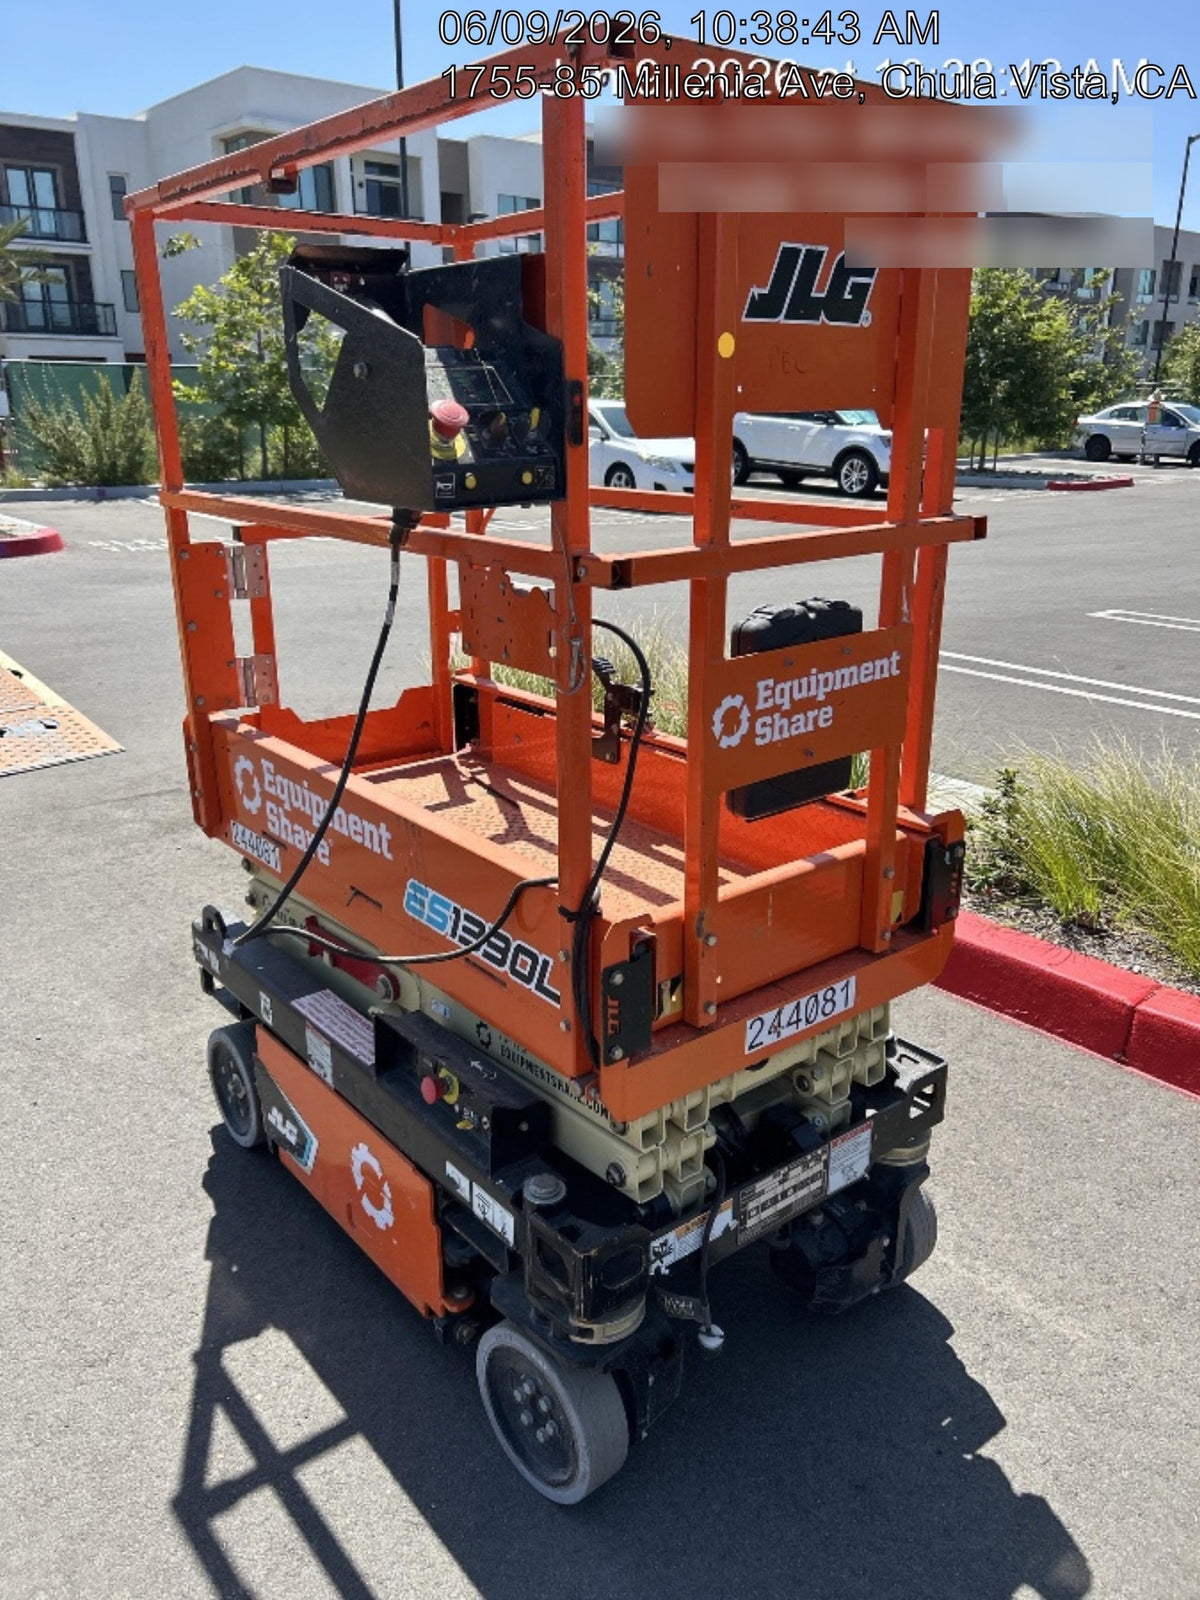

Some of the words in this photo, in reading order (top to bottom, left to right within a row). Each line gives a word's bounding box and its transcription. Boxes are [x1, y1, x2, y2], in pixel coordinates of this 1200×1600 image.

[741, 242, 879, 327] JLG
[755, 650, 901, 711] Equipment
[755, 704, 834, 747] Share
[260, 758, 394, 862] Equipment
[266, 801, 331, 867] Share
[404, 878, 561, 1009] ES1330L
[607, 994, 620, 1037] JLG
[747, 979, 851, 1052] 244081
[267, 1106, 298, 1146] JLG
